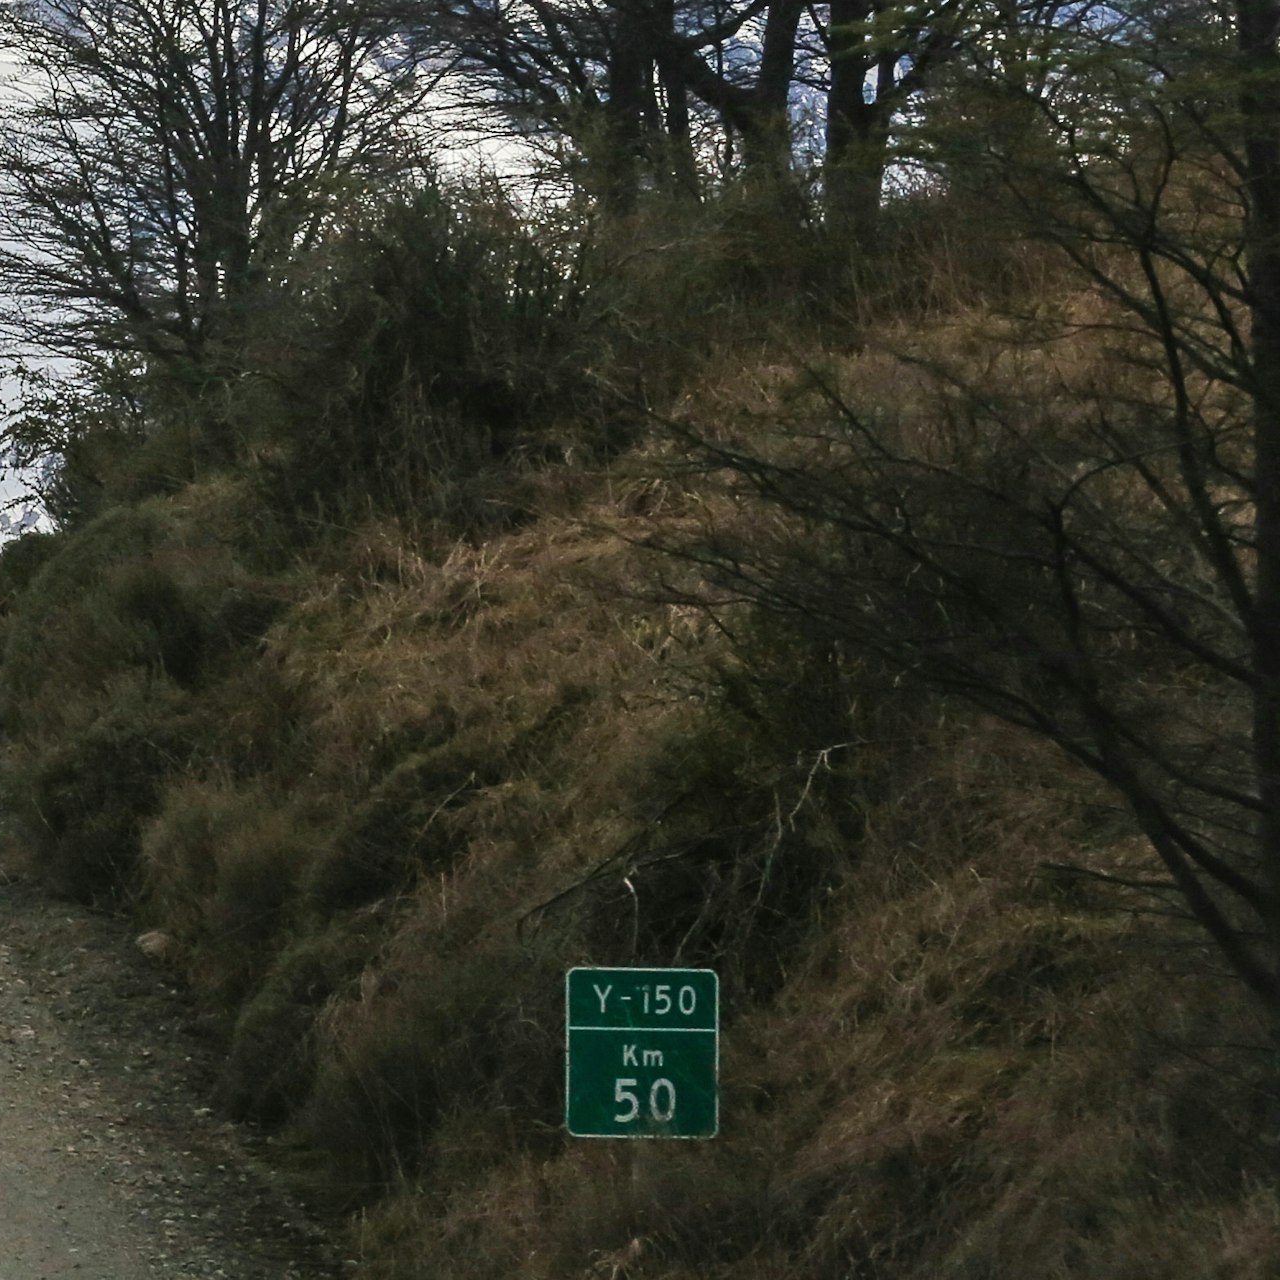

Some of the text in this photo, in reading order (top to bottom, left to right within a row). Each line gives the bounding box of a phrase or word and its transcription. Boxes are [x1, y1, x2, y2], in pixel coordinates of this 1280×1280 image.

[592, 984, 697, 1015] Y-150
[622, 1044, 664, 1067] Km
[613, 1077, 677, 1123] 50
